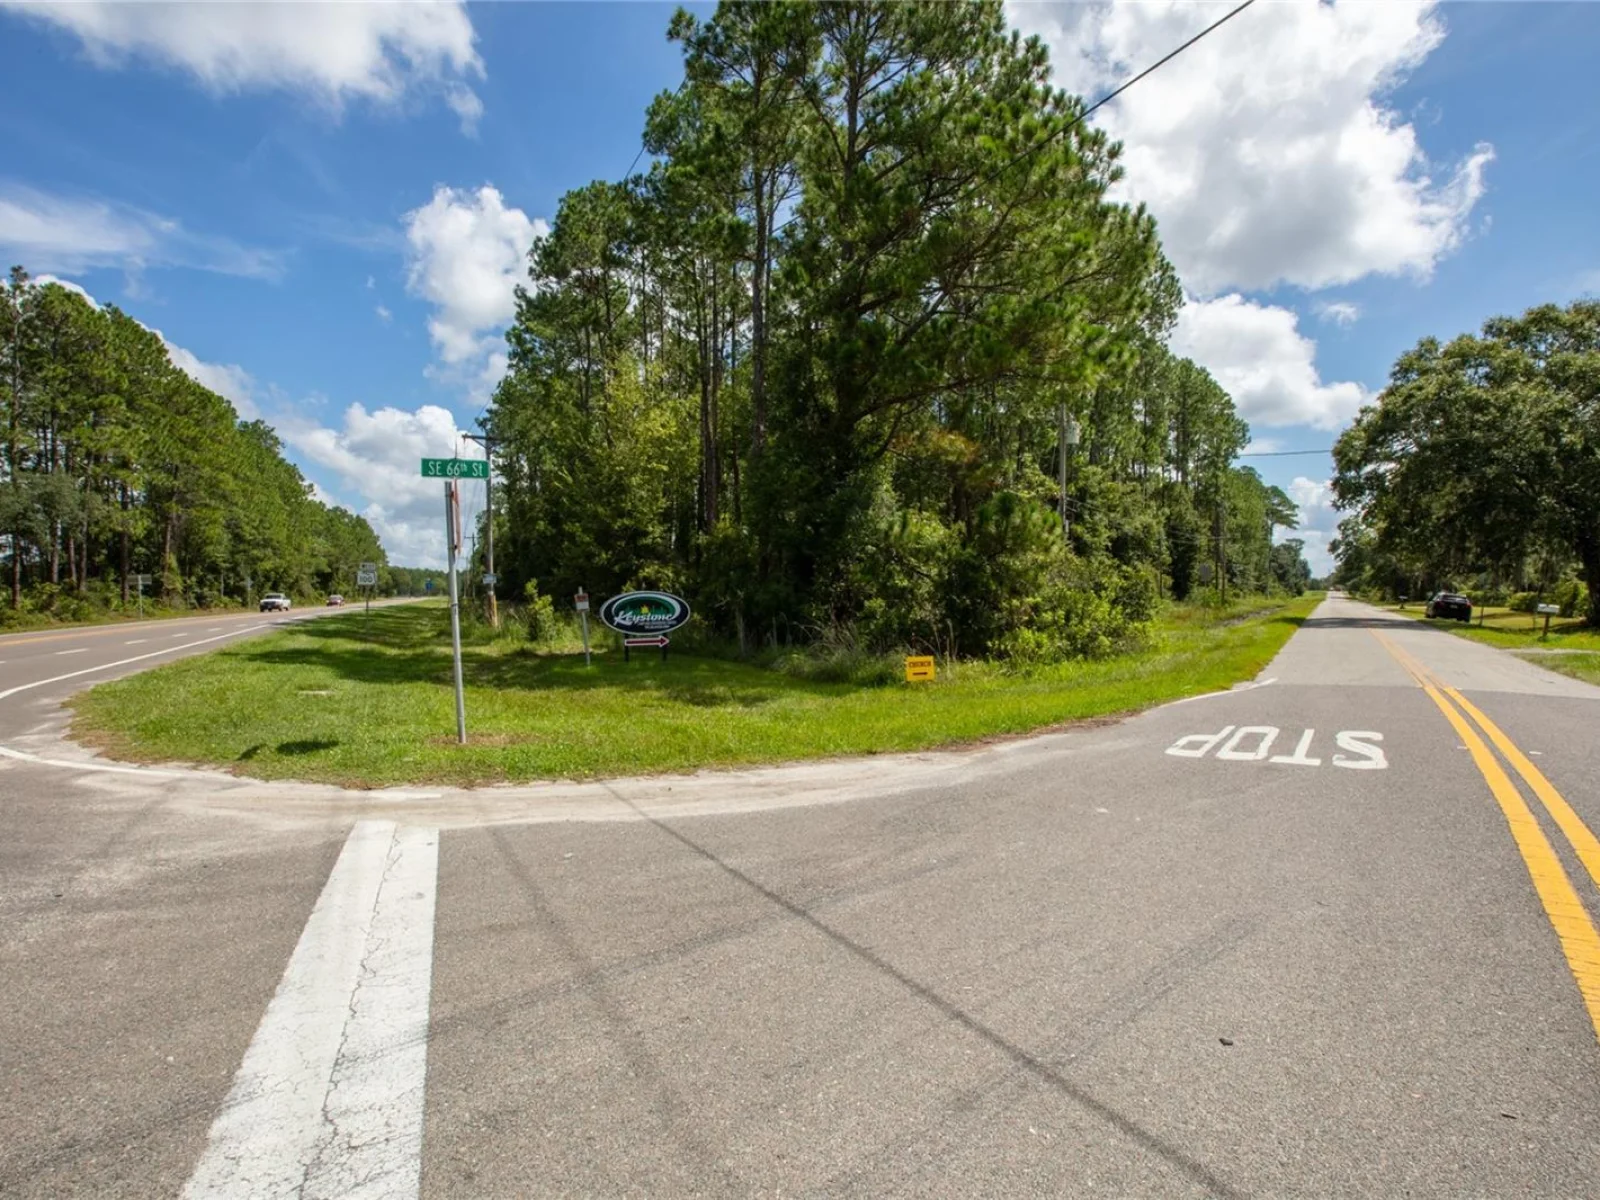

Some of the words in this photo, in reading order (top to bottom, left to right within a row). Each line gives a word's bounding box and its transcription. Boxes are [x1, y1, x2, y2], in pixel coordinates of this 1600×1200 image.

[428, 460, 442, 476] SE
[613, 610, 673, 626] Keystone
[1164, 725, 1389, 769] STOP
